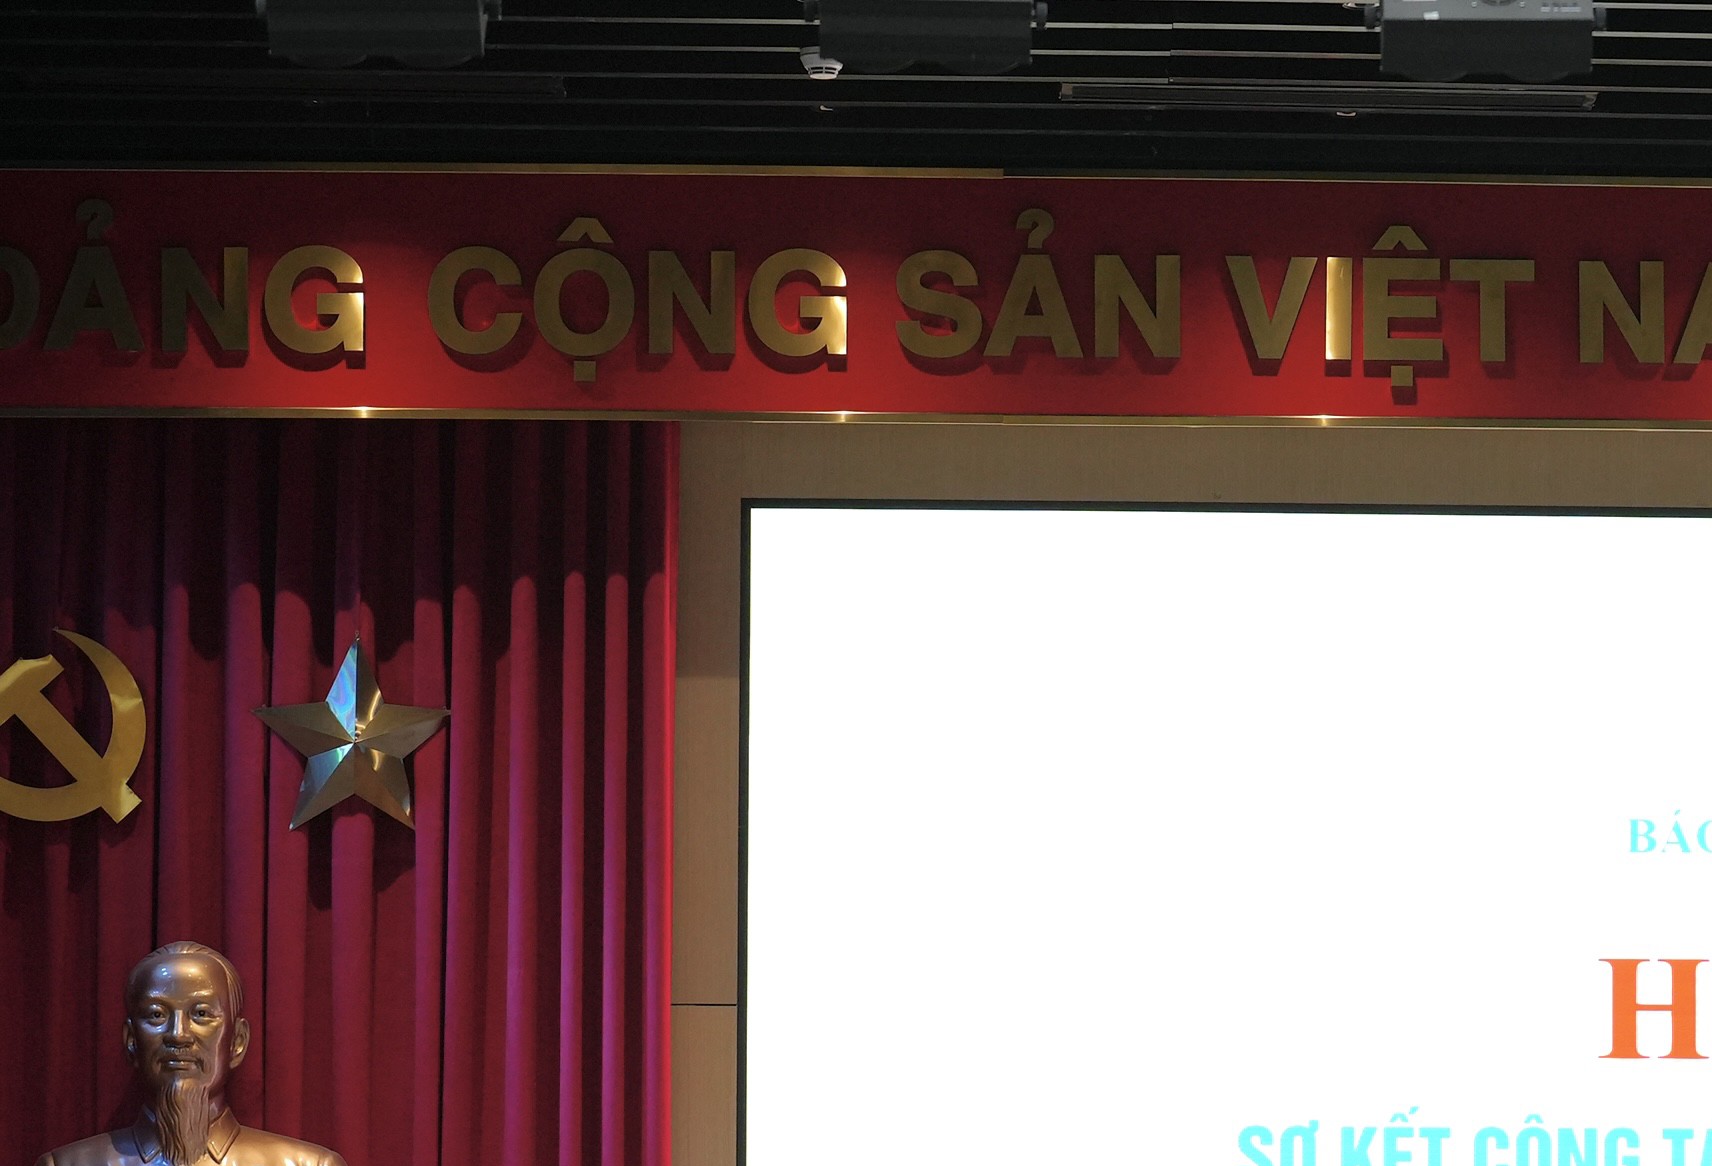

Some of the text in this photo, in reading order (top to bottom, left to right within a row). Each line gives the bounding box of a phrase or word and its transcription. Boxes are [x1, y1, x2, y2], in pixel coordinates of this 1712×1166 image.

[428, 217, 848, 381] CỘNG
[895, 209, 1181, 359] SẢN
[1226, 225, 1535, 386] VIỆT
